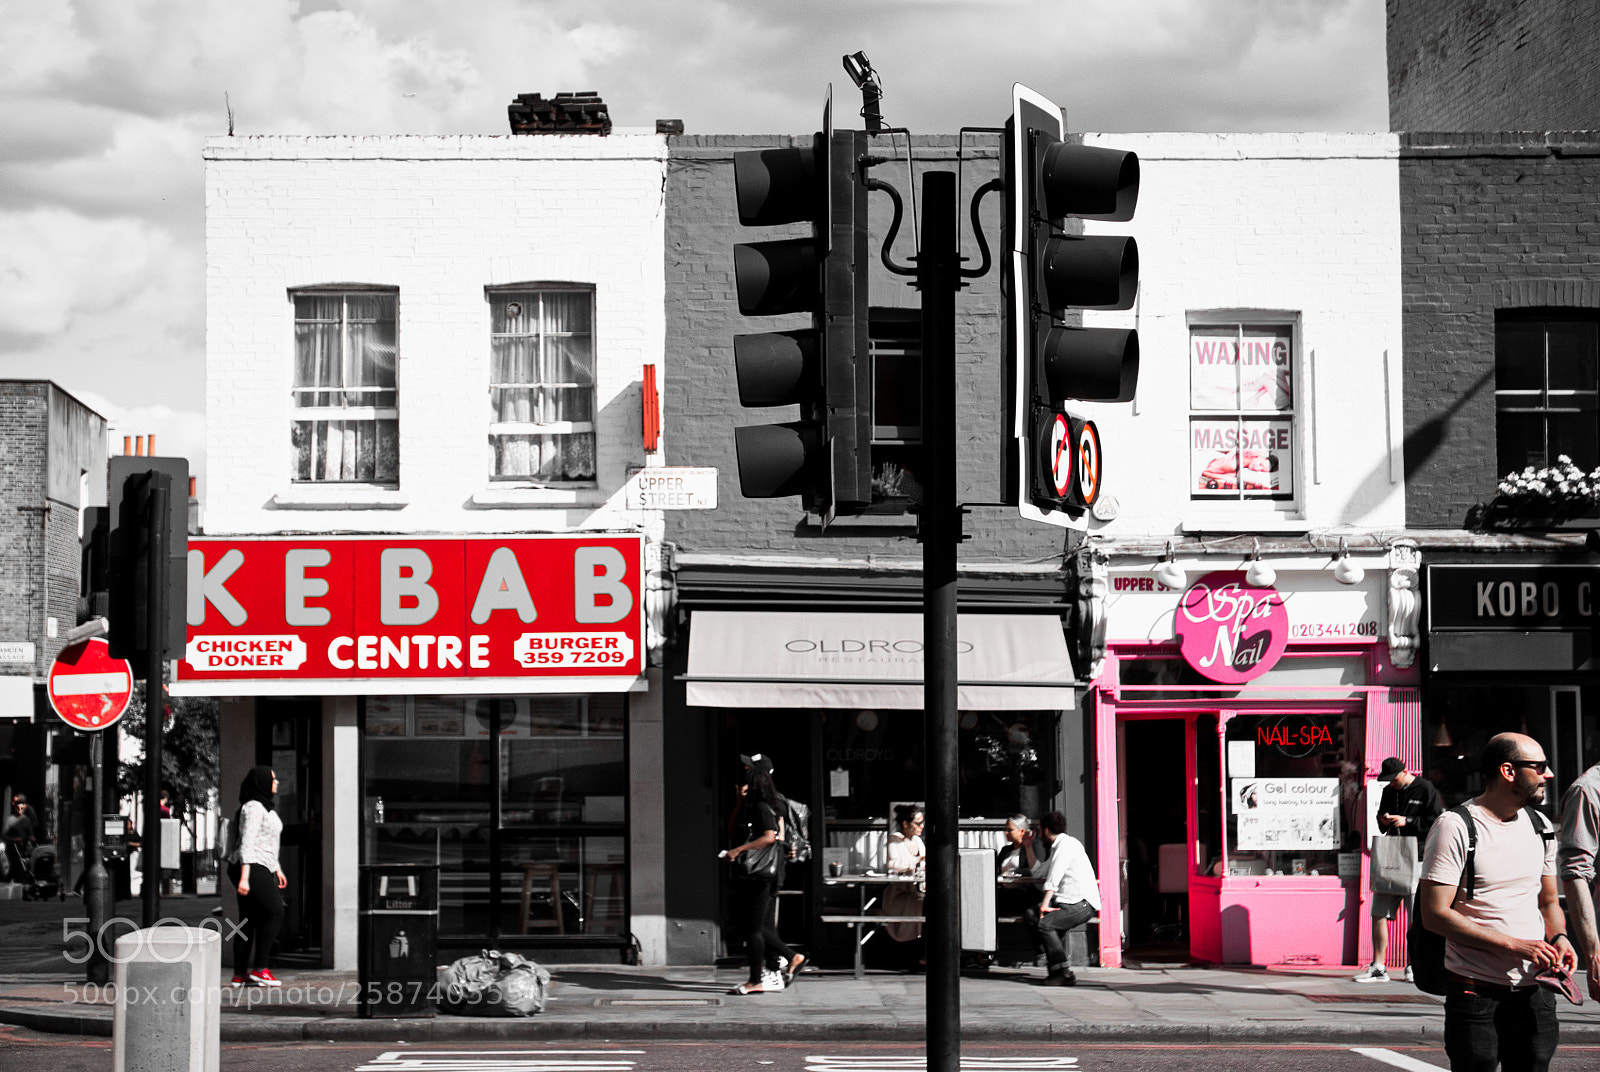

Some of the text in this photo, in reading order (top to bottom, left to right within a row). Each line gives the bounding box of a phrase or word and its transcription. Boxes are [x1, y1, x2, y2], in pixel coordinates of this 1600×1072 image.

[1195, 341, 1288, 366] WAXING
[1194, 428, 1289, 450] MASSAGE
[638, 477, 684, 490] UPPER
[638, 492, 694, 506] STREET
[186, 546, 634, 627] KEBAB
[1113, 577, 1154, 592] UPPER
[1476, 580, 1560, 617] KOBO
[1182, 582, 1277, 634] Spa
[196, 640, 293, 653] CHICKEN
[529, 637, 619, 650] BURGER
[785, 639, 974, 654] OLDROD
[1199, 624, 1265, 668] Nail
[327, 634, 491, 671] CENTRE
[523, 651, 625, 664] 359 7209
[207, 654, 285, 667] DONER
[1257, 724, 1334, 746] NAIL-SPA
[1264, 782, 1328, 794] Gel colour
[385, 899, 413, 909] Litter
